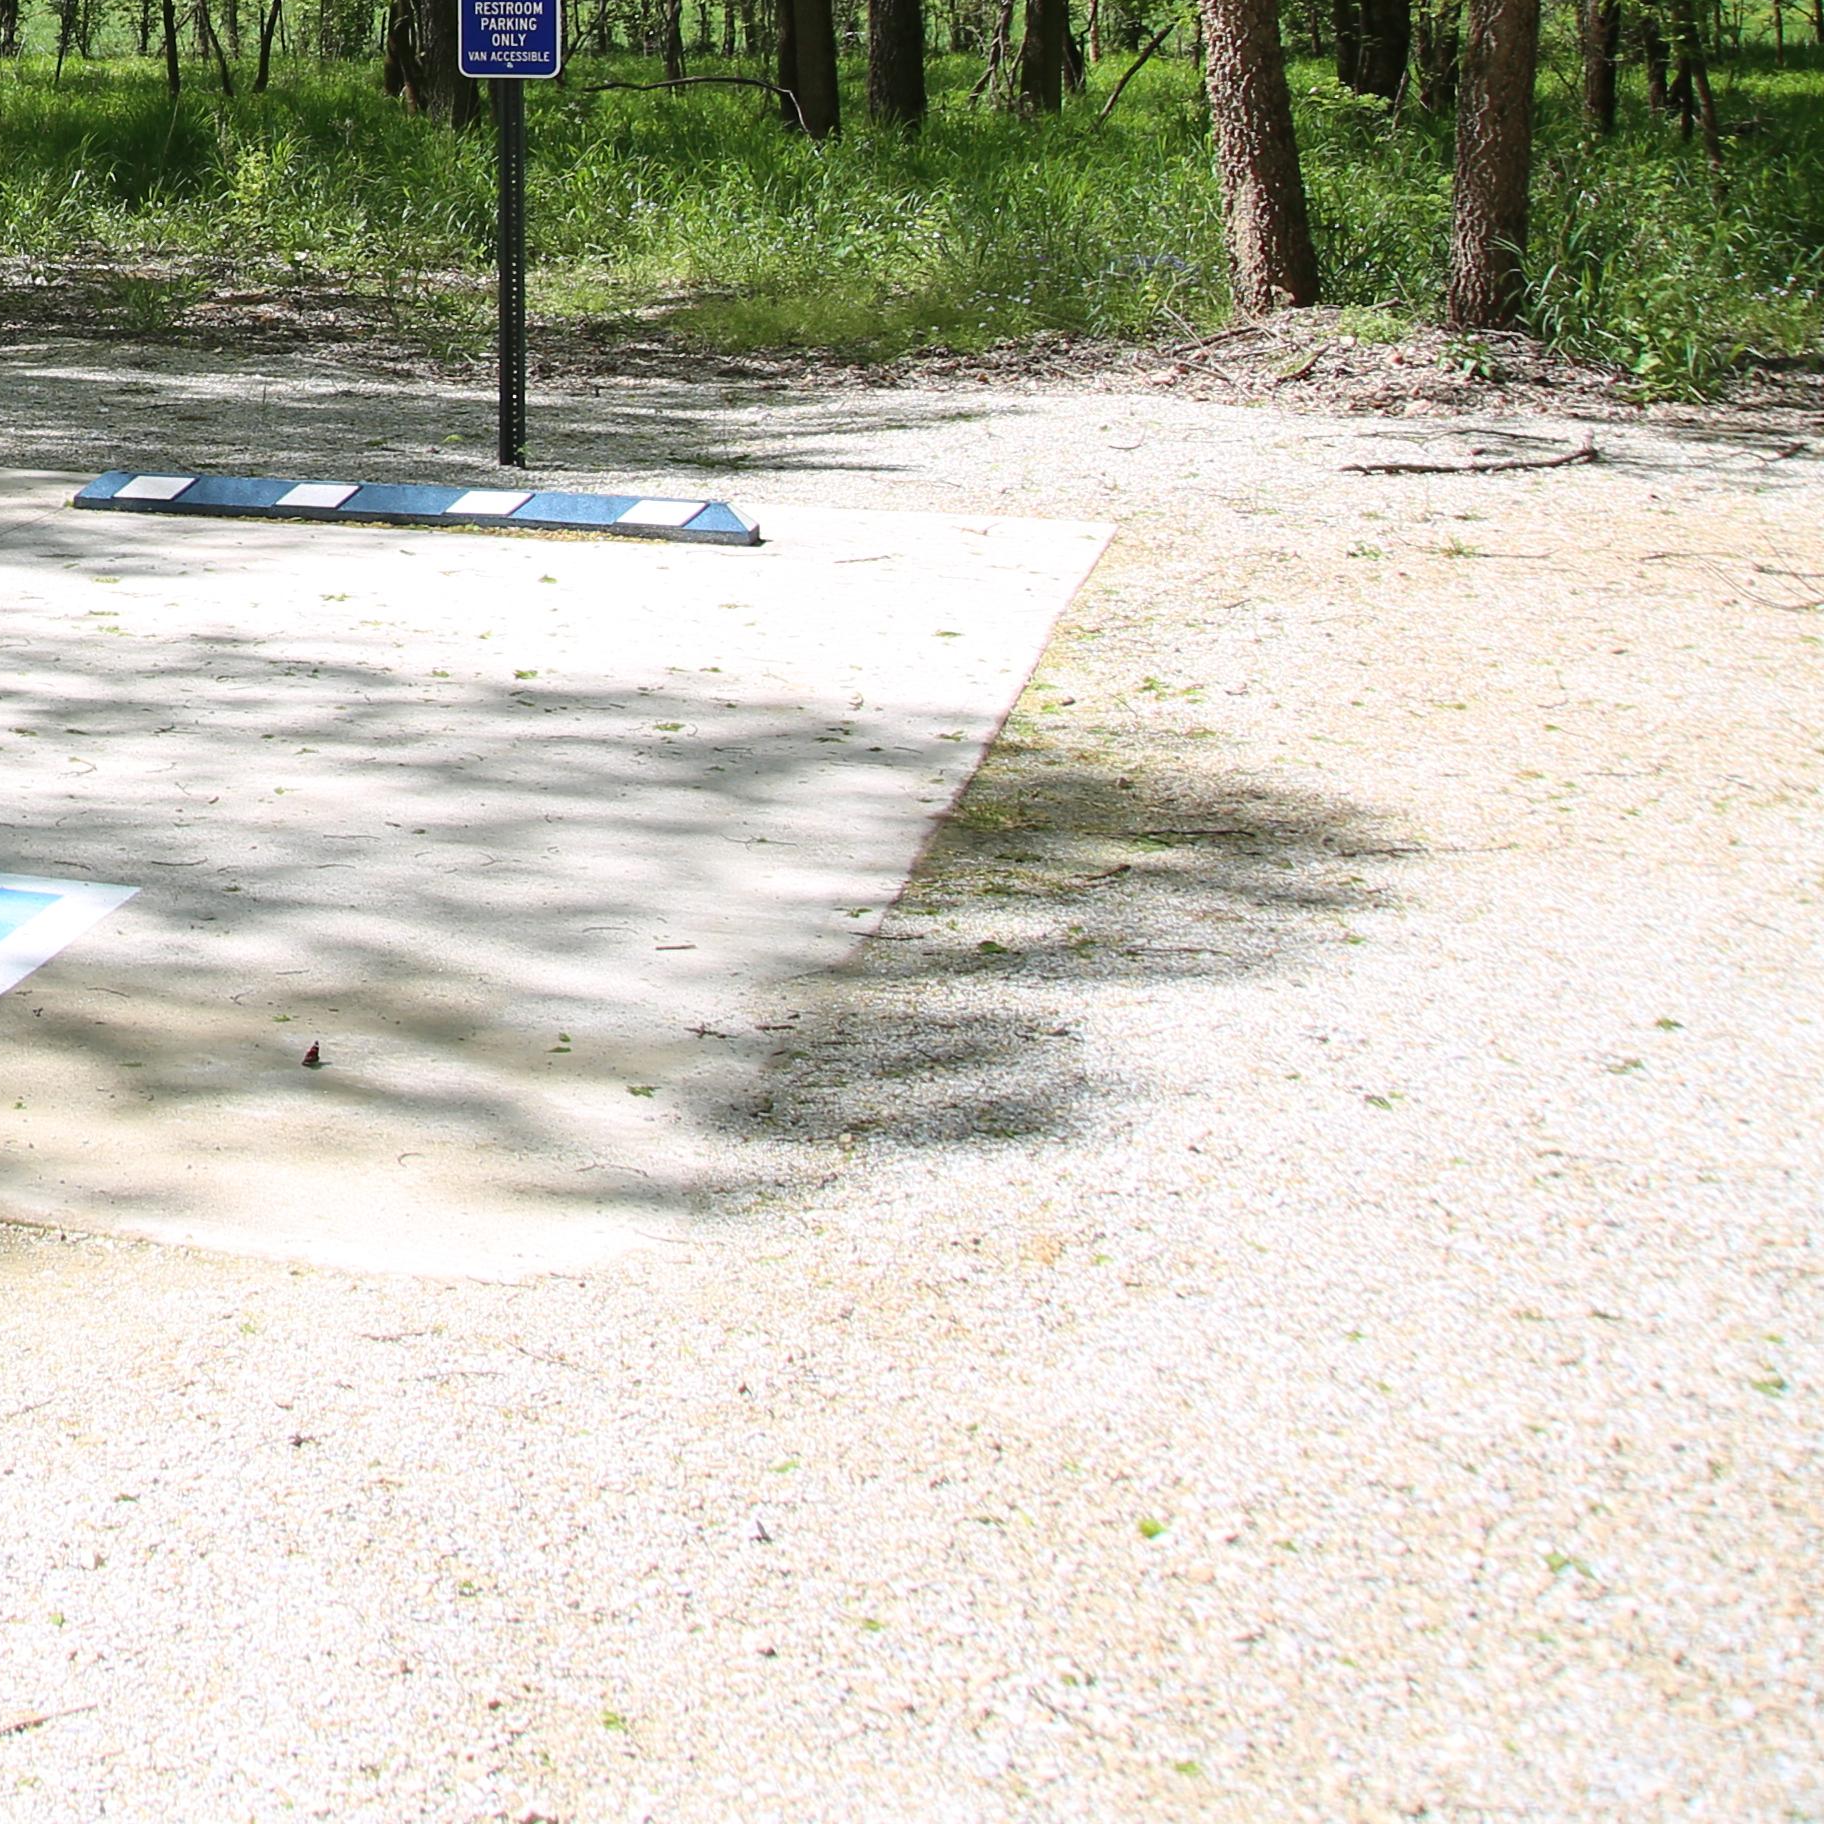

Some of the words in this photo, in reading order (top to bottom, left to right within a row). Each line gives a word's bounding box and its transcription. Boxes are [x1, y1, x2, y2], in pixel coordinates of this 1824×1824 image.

[474, 1, 543, 15] RESTROOM
[480, 17, 537, 31] PARKING
[491, 34, 527, 47] ONLY
[468, 51, 487, 62] VAN
[490, 51, 550, 62] ACCESSIBLE
